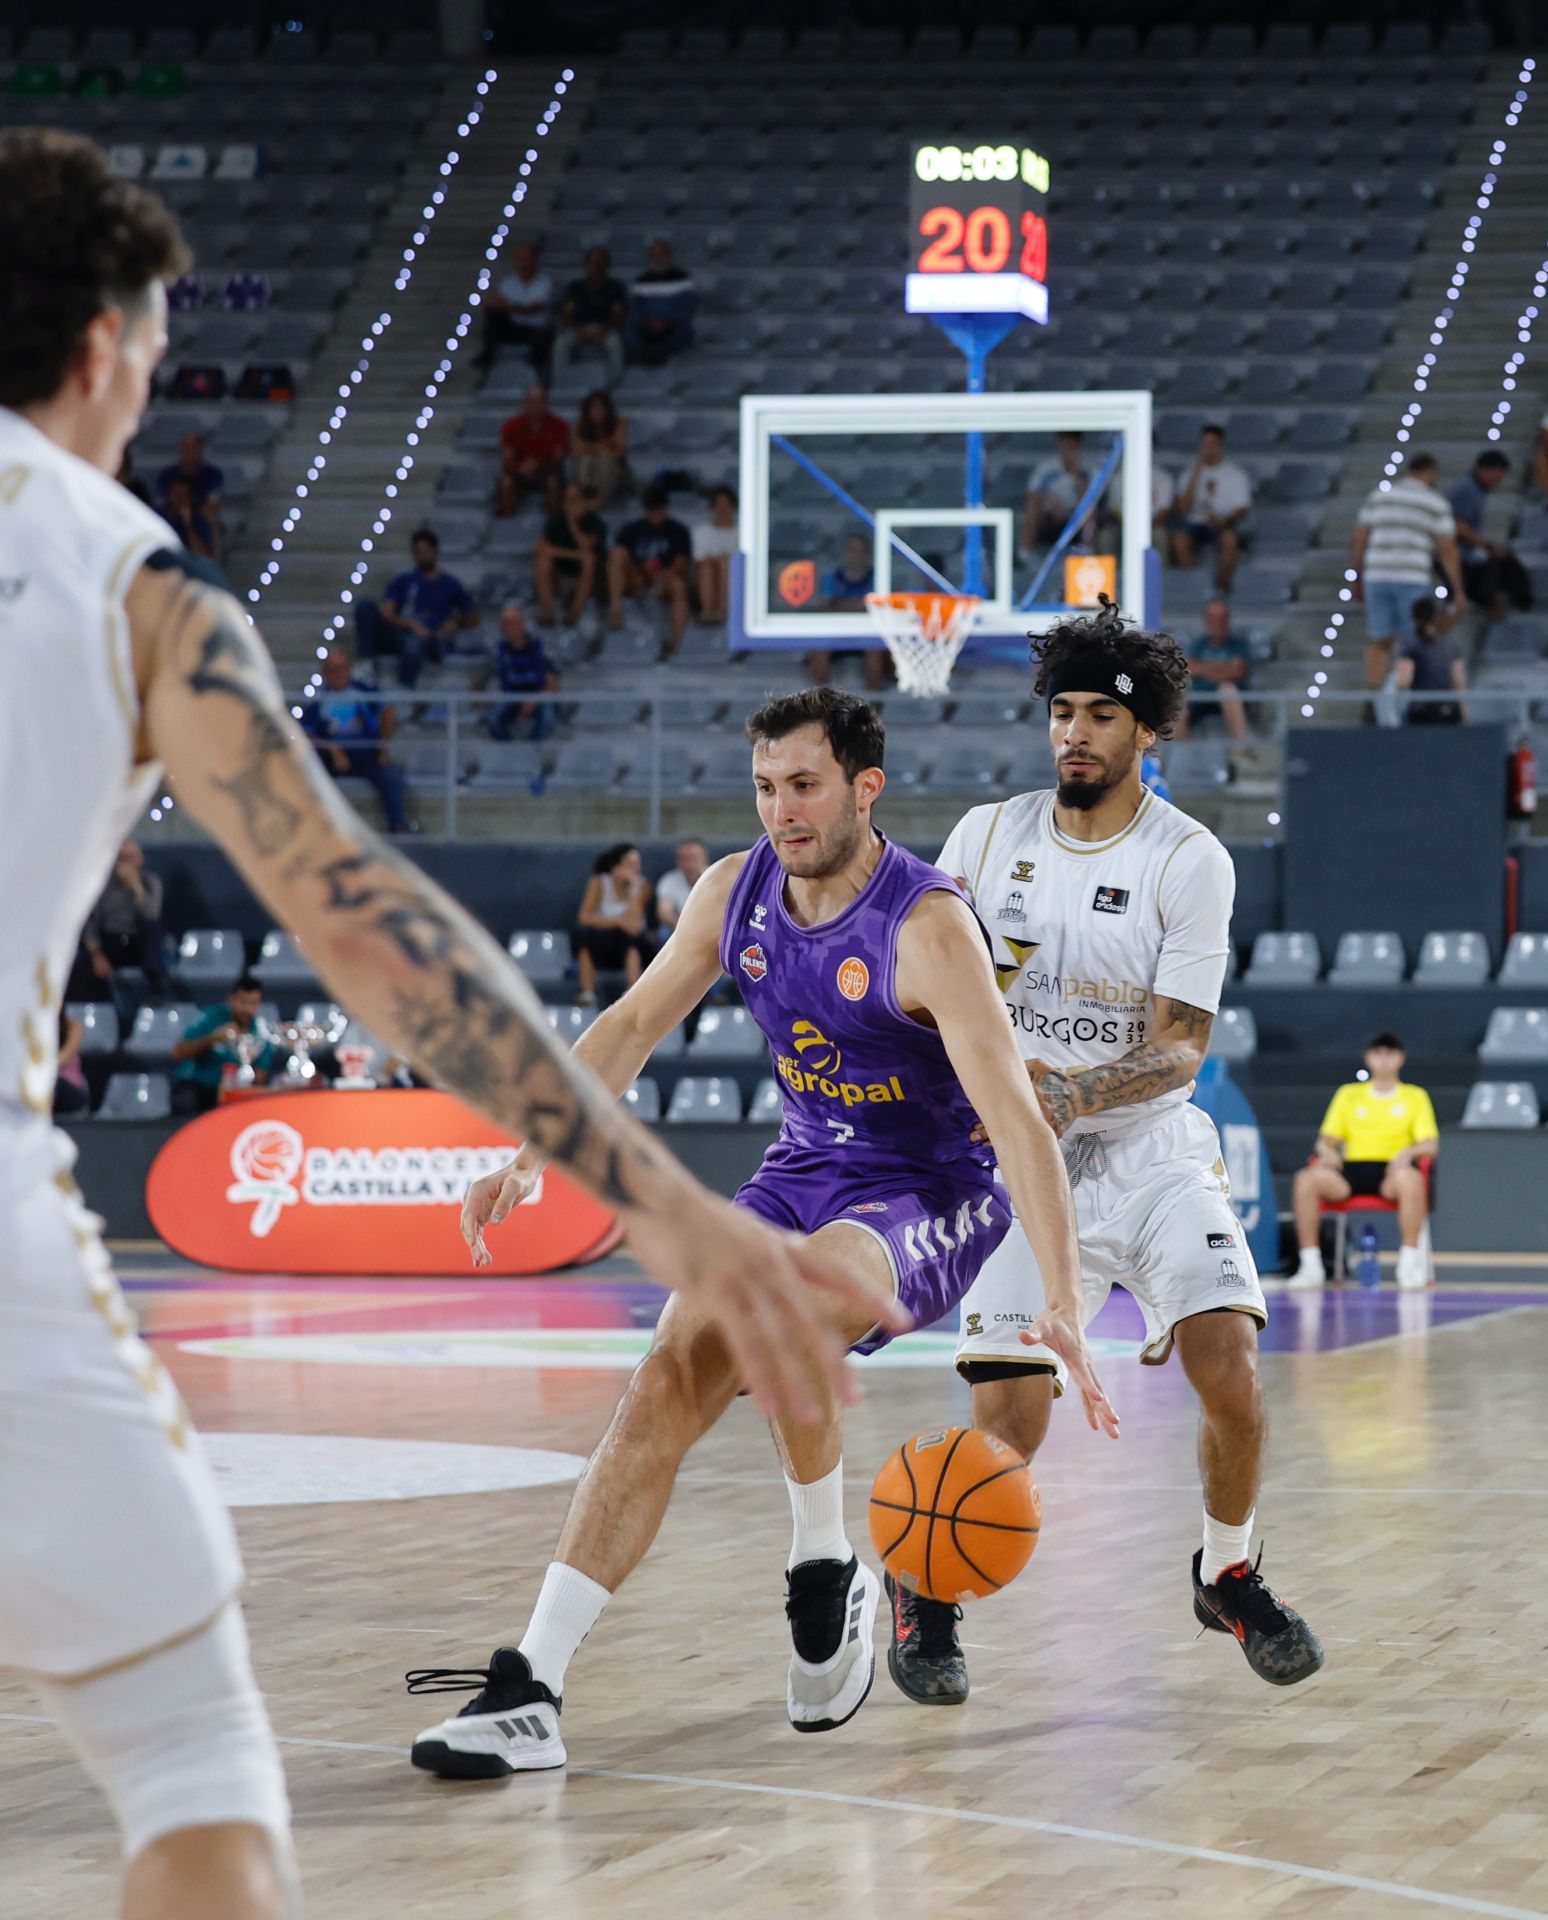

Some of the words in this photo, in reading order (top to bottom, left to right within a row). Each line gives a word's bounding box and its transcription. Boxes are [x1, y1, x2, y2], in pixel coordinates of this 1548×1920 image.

[918, 206, 1011, 273] 20
[1097, 893, 1113, 904] liga
[1095, 902, 1126, 913] endesa
[1079, 1000, 1146, 1013] INMOBILIARIA
[778, 1061, 905, 1107] agropal
[827, 1118, 855, 1143] 7
[312, 1155, 510, 1171] BALONCEST
[311, 1179, 432, 1196] CASTILLA
[442, 1178, 456, 1195] Y
[994, 1313, 1039, 1323] CASTILL
